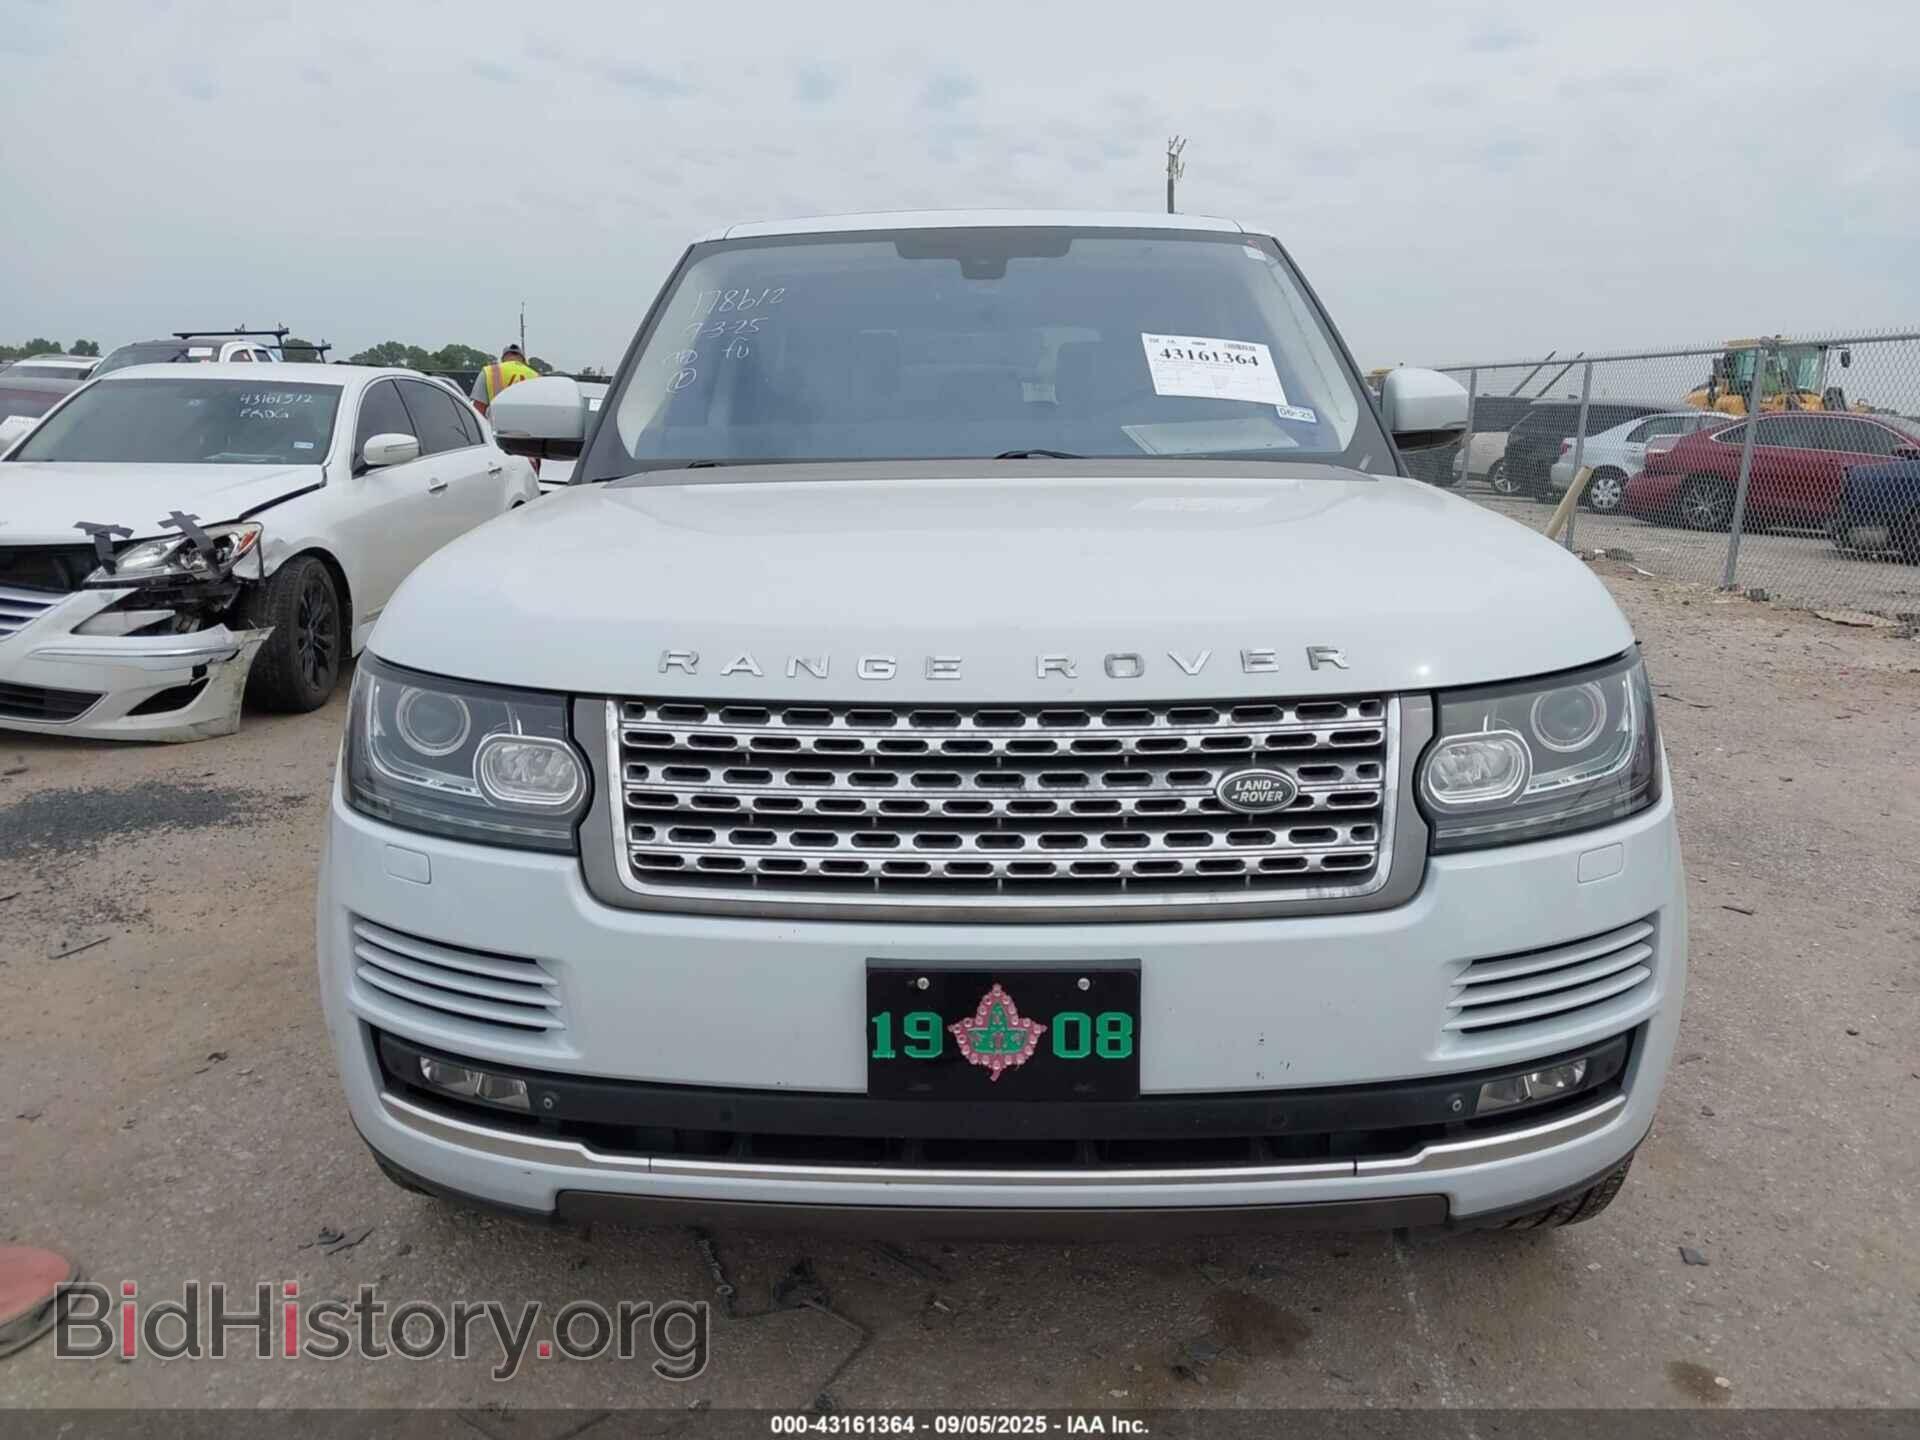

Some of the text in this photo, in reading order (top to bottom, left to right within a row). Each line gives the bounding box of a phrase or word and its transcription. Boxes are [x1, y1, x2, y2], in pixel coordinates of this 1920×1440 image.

[1159, 347, 1259, 367] 43161364
[658, 645, 1350, 681] RANGE ROVER
[1235, 780, 1272, 791] LAND
[1239, 791, 1283, 802] ROVER
[871, 1011, 944, 1060] 19
[1052, 1011, 1134, 1060] 08
